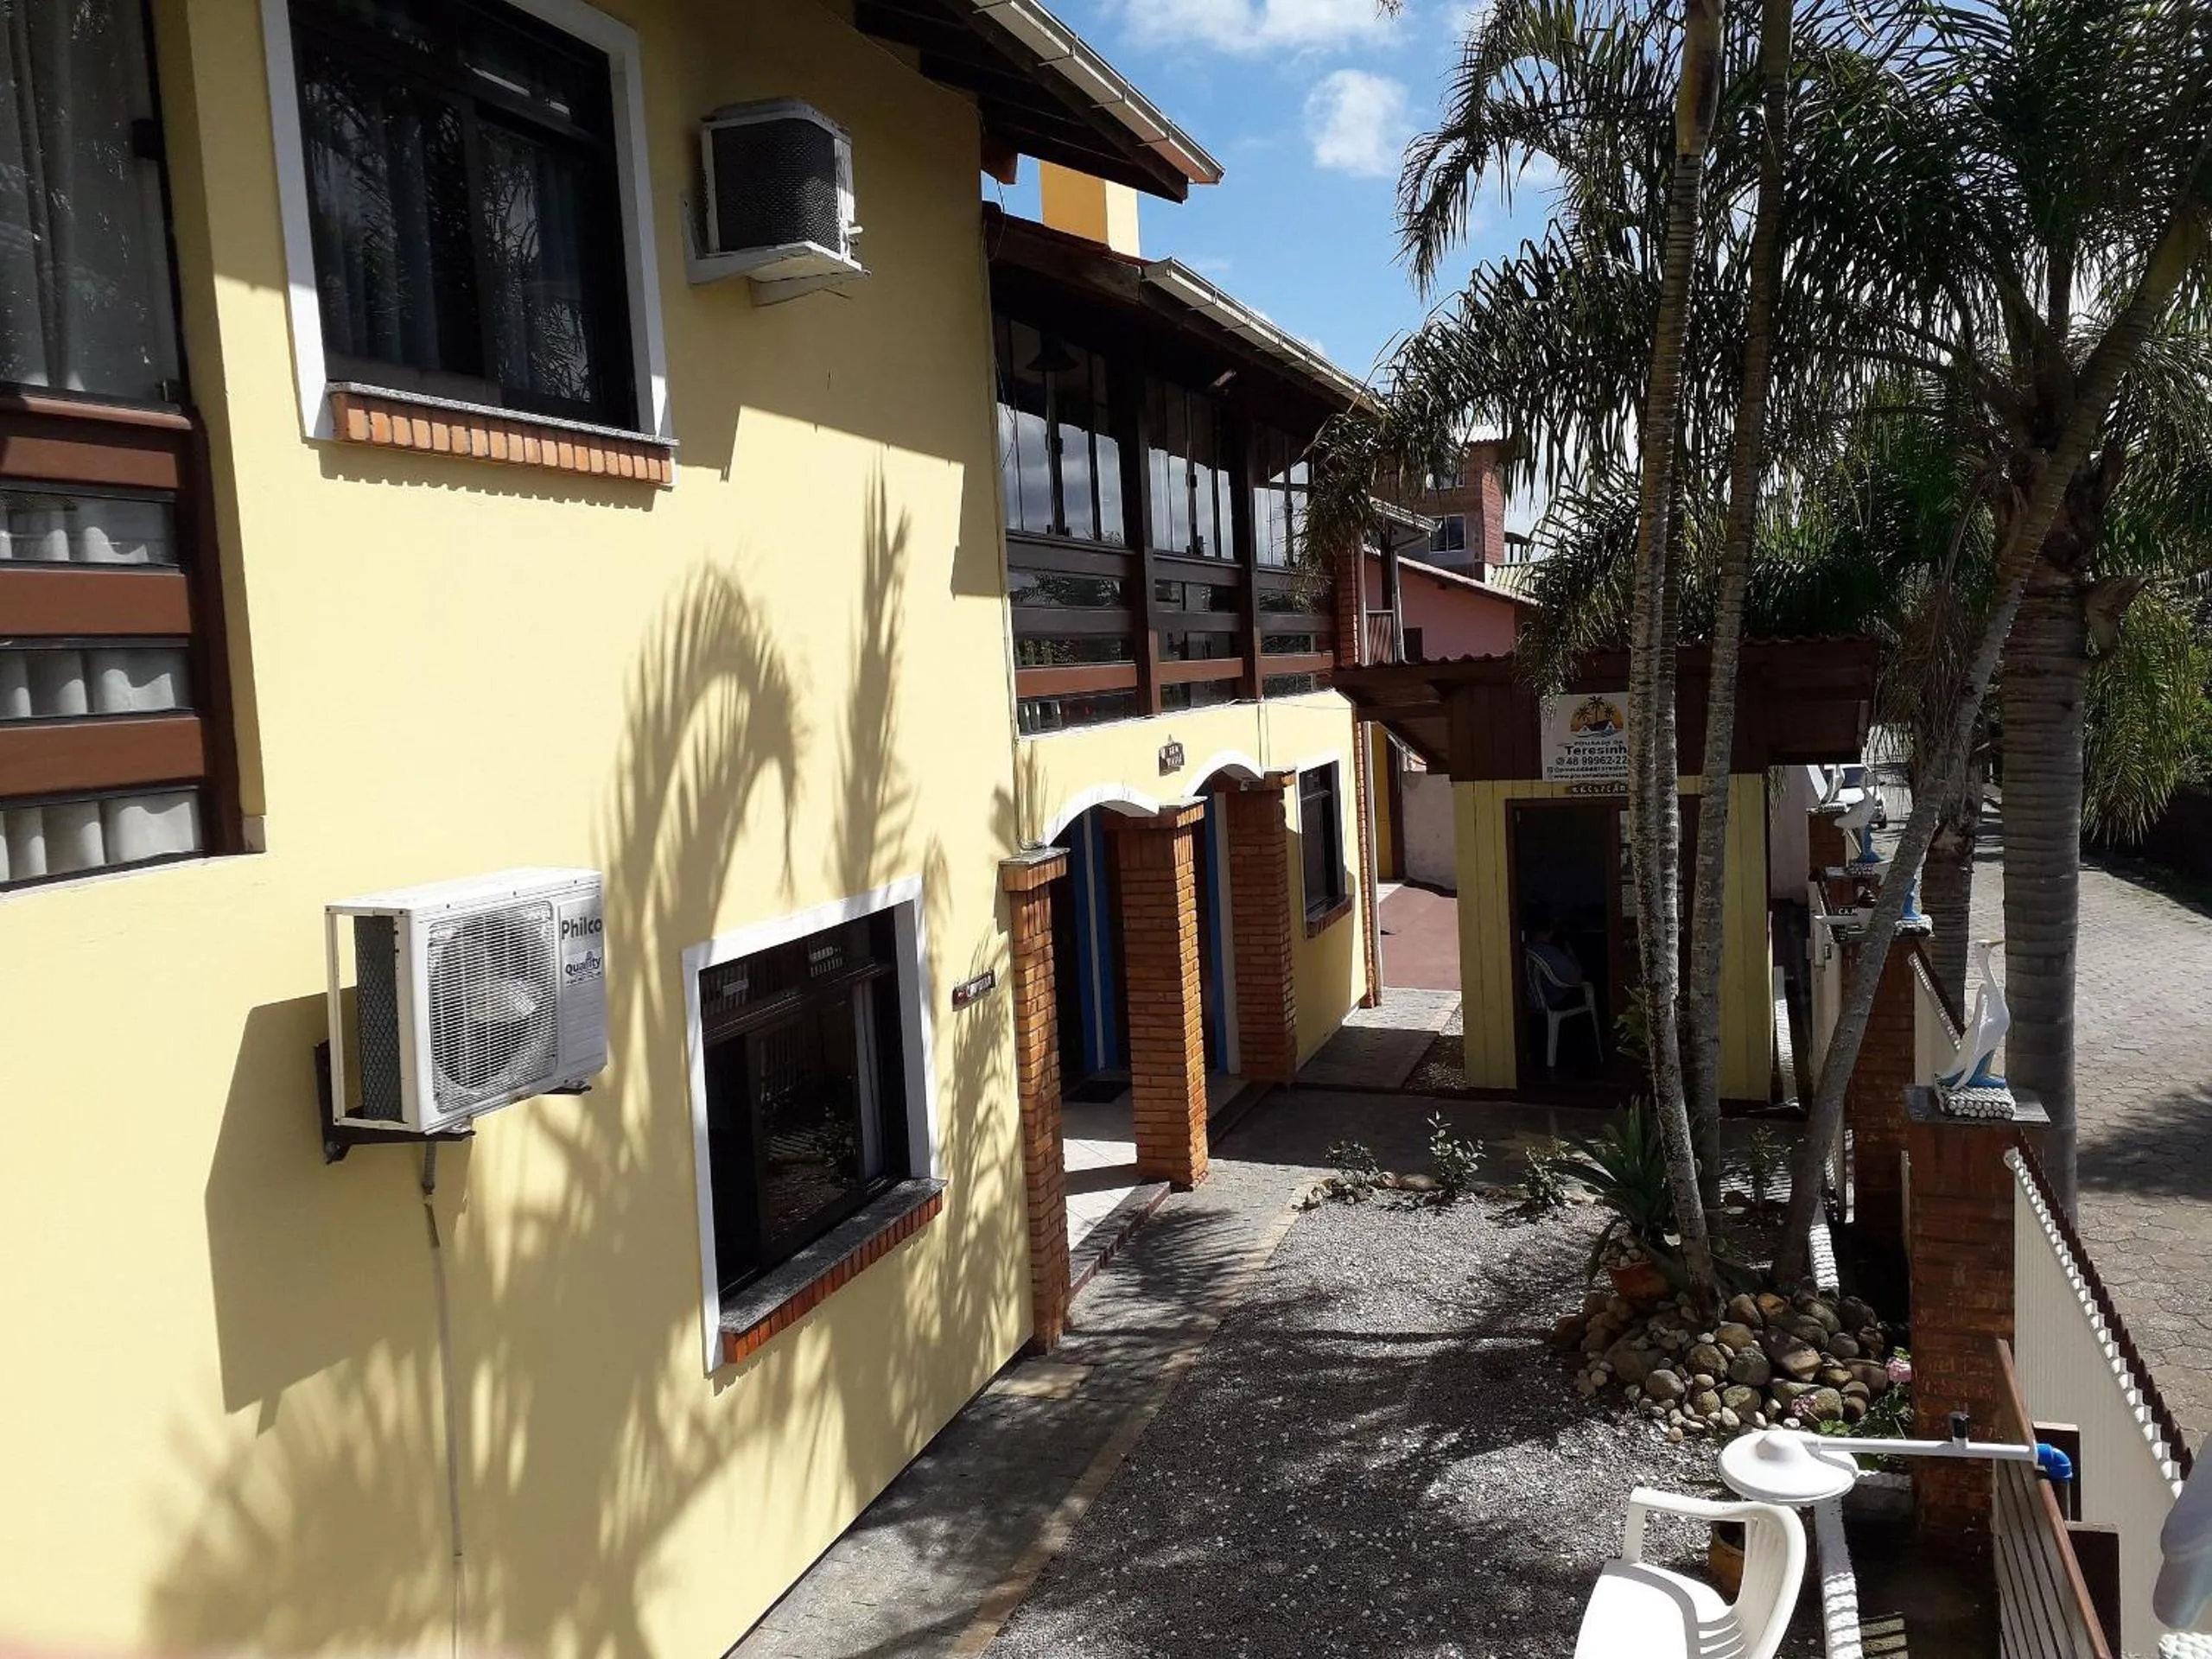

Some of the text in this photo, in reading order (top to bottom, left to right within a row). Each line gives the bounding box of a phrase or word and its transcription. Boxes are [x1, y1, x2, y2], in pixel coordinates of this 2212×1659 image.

[1564, 745, 1627, 755] Teresinh
[1581, 755, 1628, 766] 99962-22
[561, 917, 602, 939] Philco
